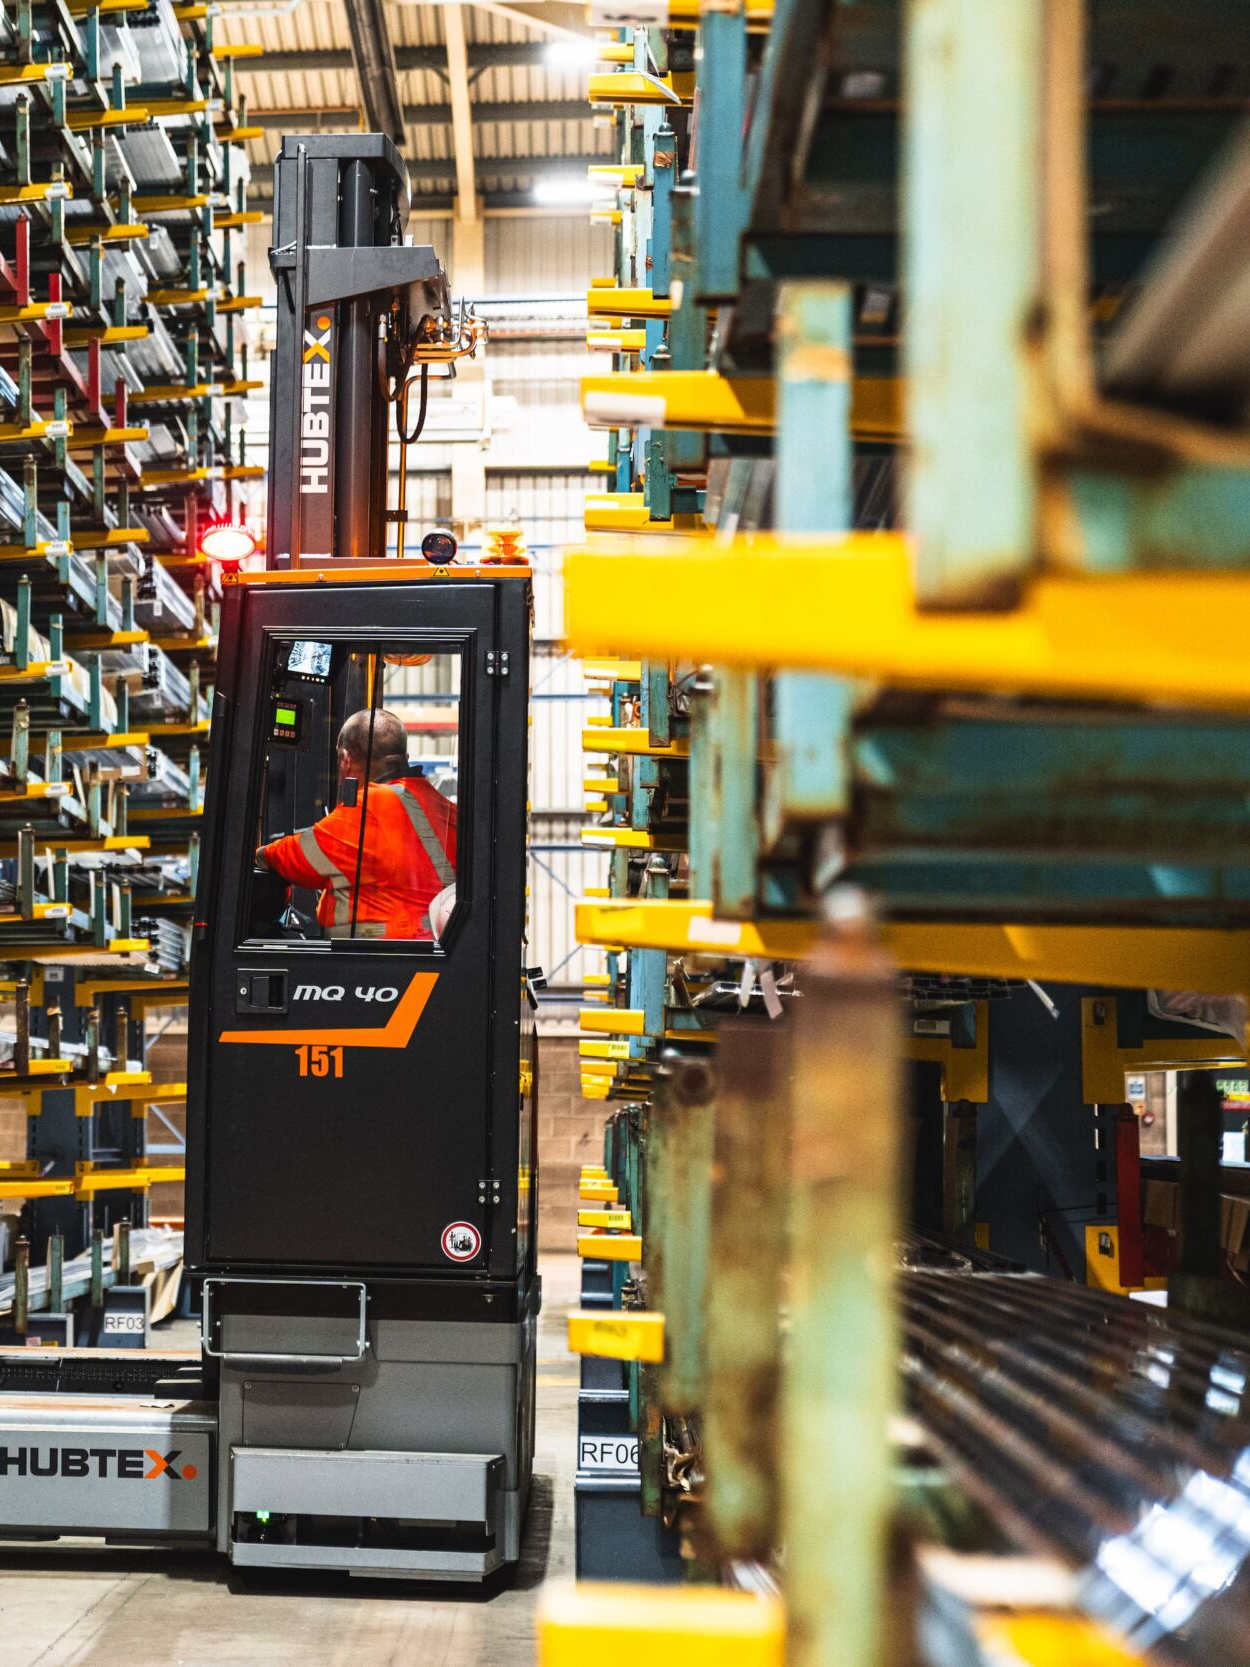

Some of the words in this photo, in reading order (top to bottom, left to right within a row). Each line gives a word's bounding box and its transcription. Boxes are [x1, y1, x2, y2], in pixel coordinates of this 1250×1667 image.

[355, 987, 399, 1003] 40
[295, 1045, 344, 1078] 151
[105, 1316, 144, 1330] RF03
